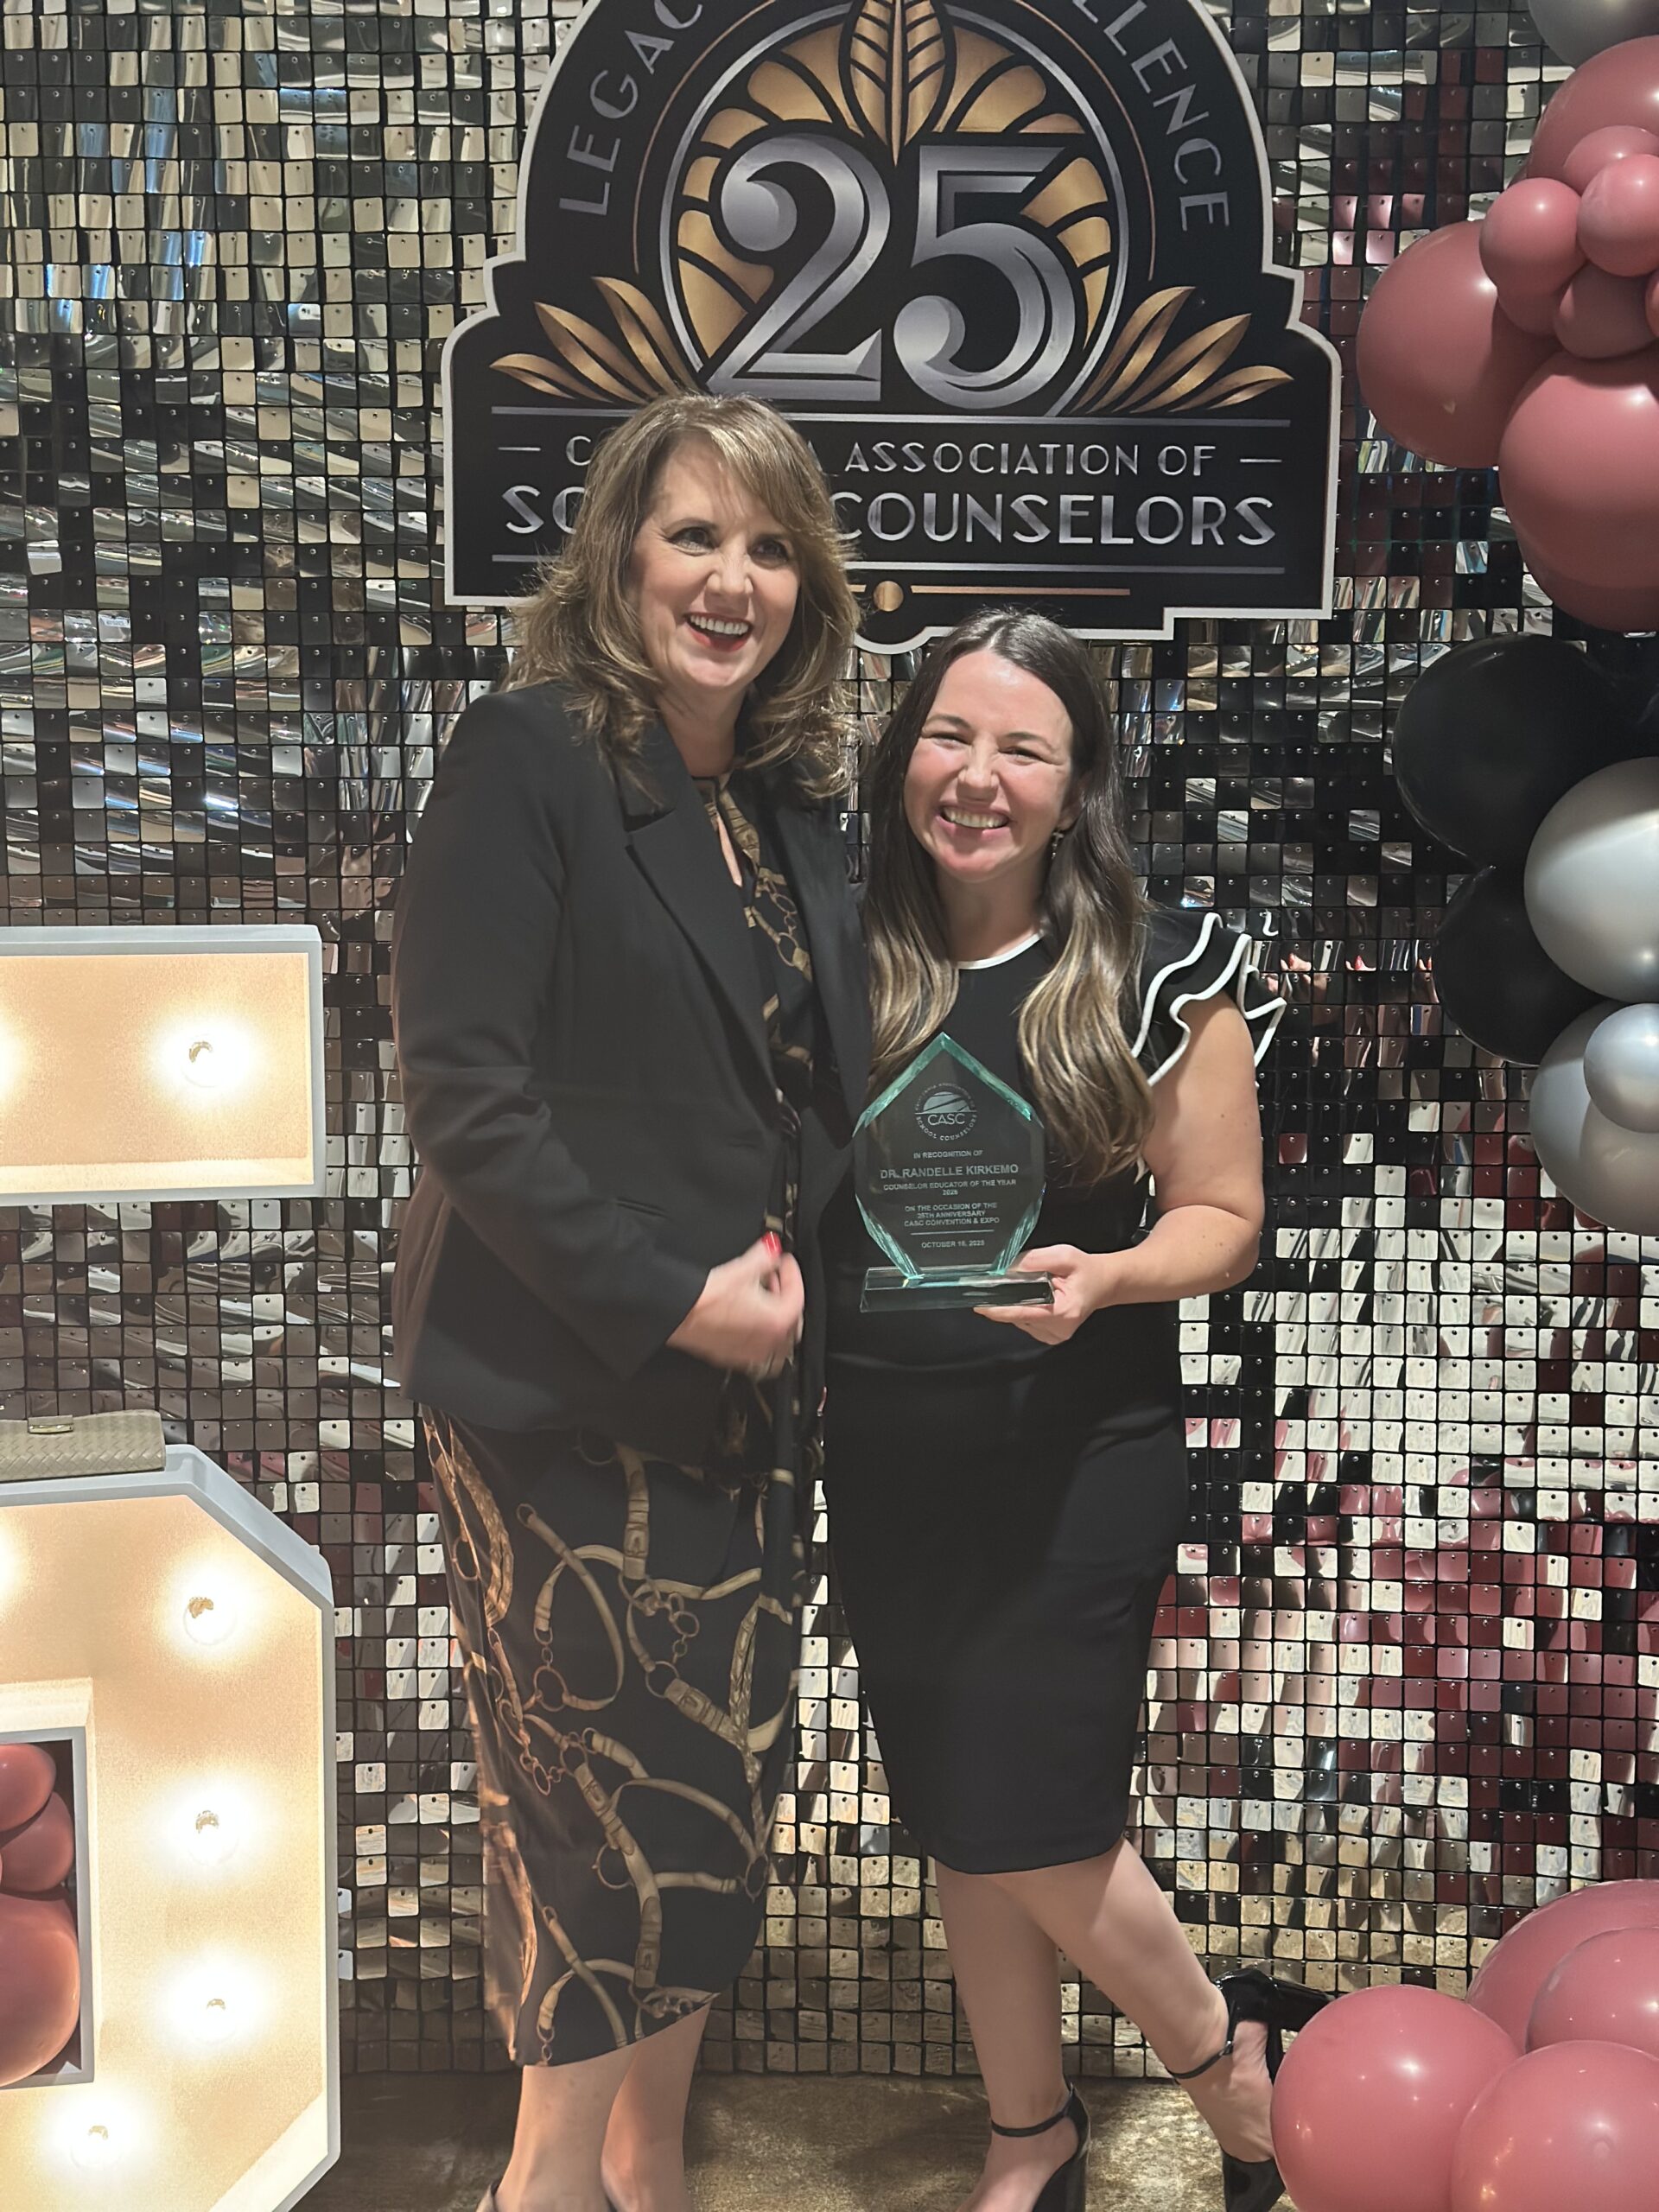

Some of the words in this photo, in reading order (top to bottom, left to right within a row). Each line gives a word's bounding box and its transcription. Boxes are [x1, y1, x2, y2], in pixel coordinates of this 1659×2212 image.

[706, 132, 1076, 410] 25
[844, 442, 1139, 475] ASSOCIATION
[1157, 445, 1216, 476] OF
[830, 492, 1275, 546] COUNSELORS
[927, 1112, 966, 1126] CASC
[922, 1150, 972, 1159] RECOGNITION
[902, 1166, 963, 1178] RANDELLE
[966, 1164, 1019, 1175] KIRKEMO
[883, 1182, 927, 1191] COUNSELOR
[930, 1180, 969, 1189] EDUCATOR
[933, 1203, 970, 1211] OCCASION
[936, 1210, 986, 1218] ANNIVERSARY
